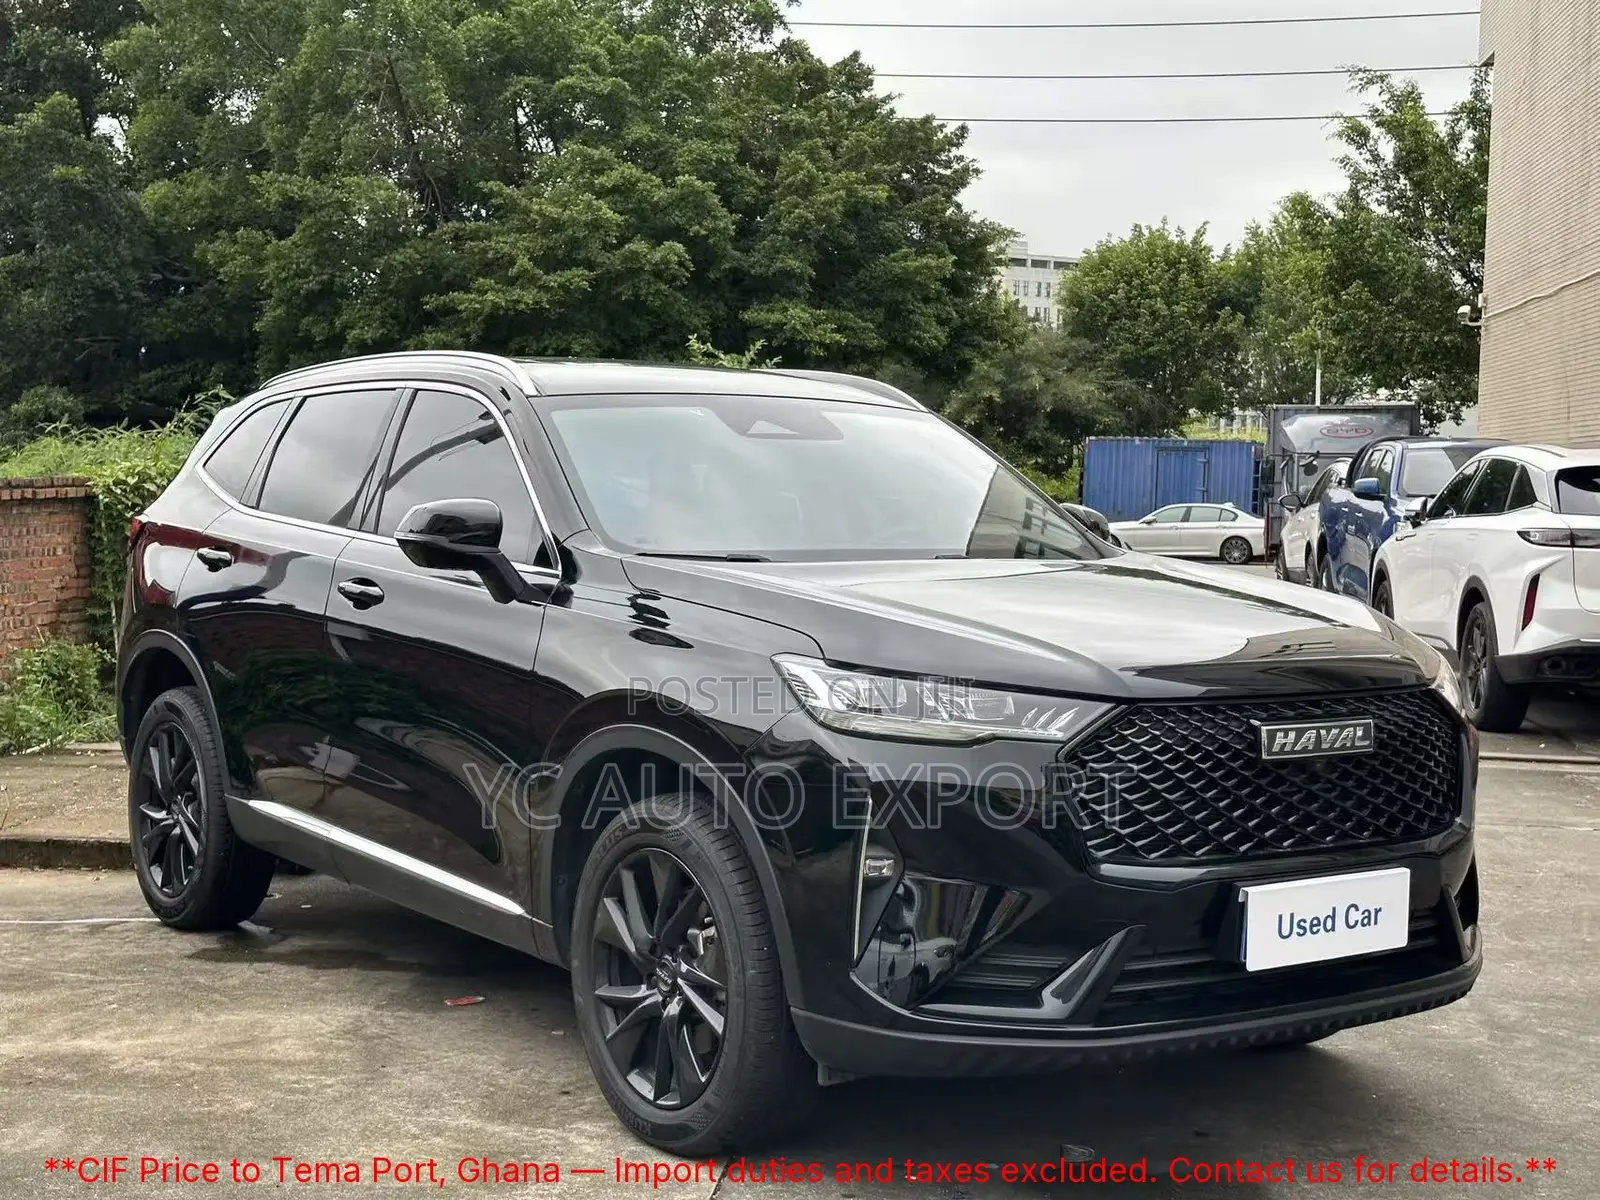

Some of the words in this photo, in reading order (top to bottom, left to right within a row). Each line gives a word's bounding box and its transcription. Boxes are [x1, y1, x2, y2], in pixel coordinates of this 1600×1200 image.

[1272, 726, 1371, 752] HAVAL
[1277, 906, 1336, 940] Used
[1344, 903, 1383, 930] Car
